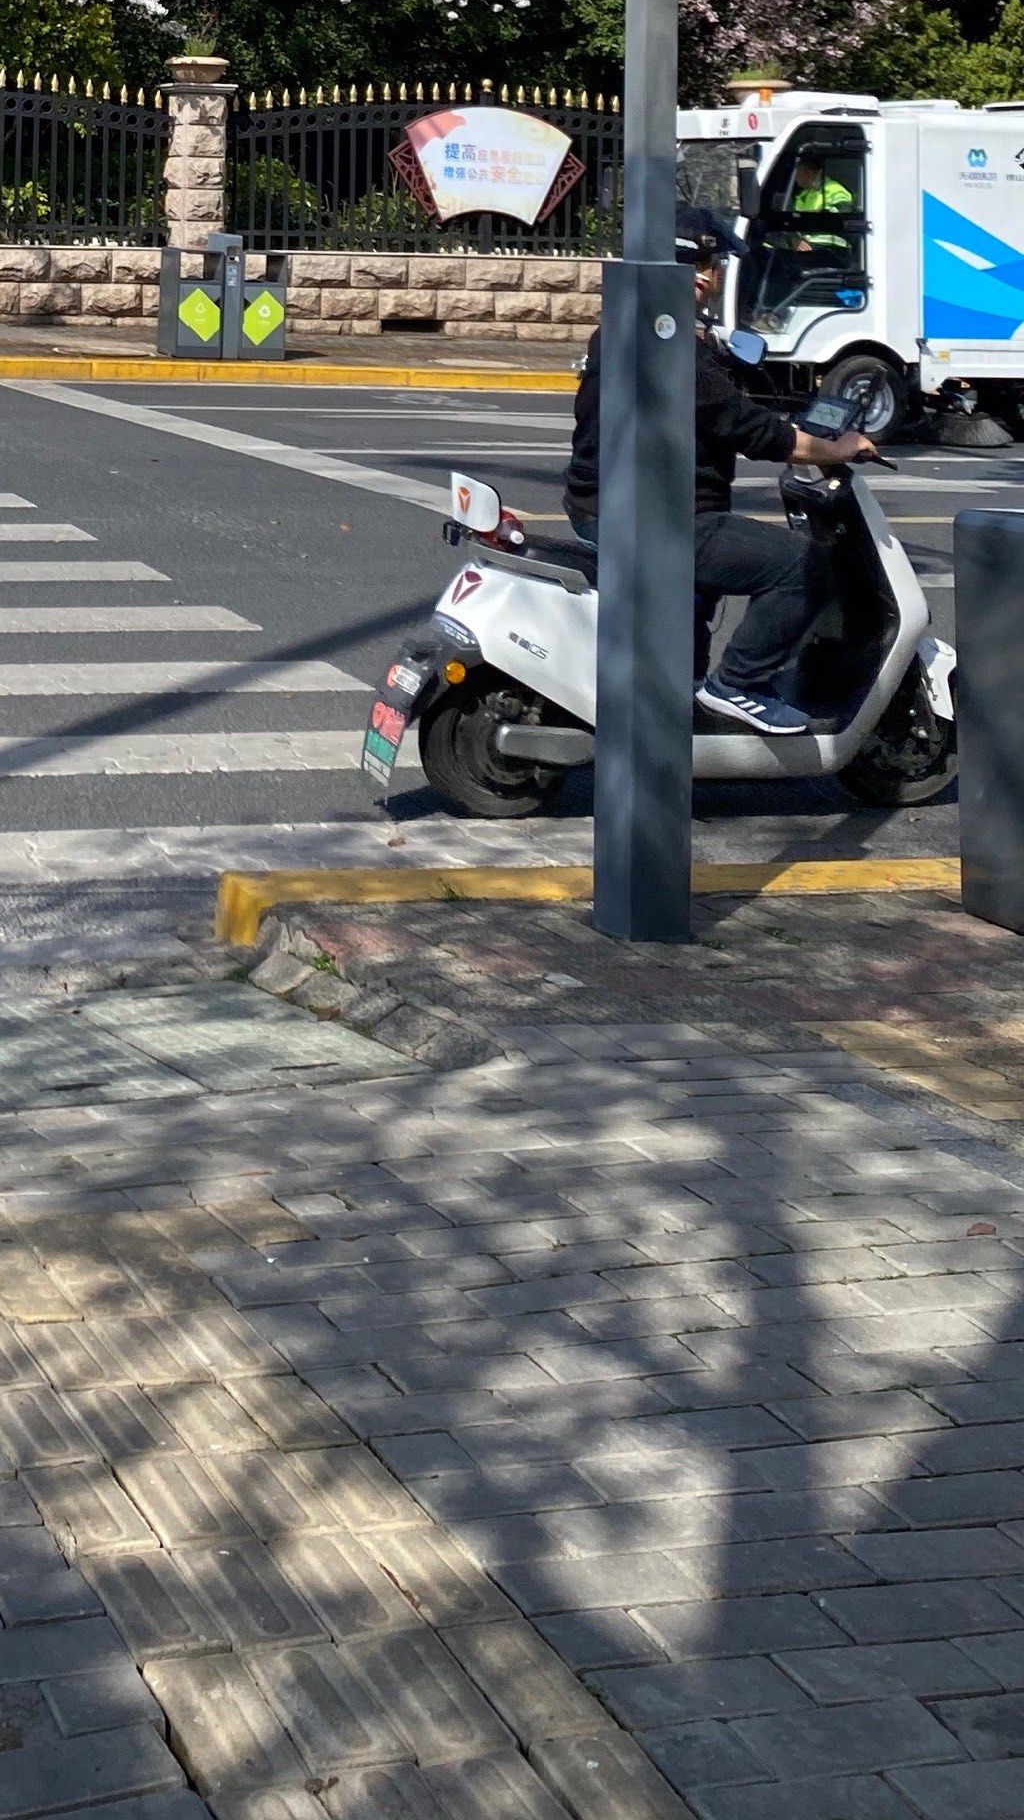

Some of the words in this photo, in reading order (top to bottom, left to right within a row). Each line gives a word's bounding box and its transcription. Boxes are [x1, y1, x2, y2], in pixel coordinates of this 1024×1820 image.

[445, 143, 545, 165] 提高应急
[443, 165, 543, 185] 增强公共安全
